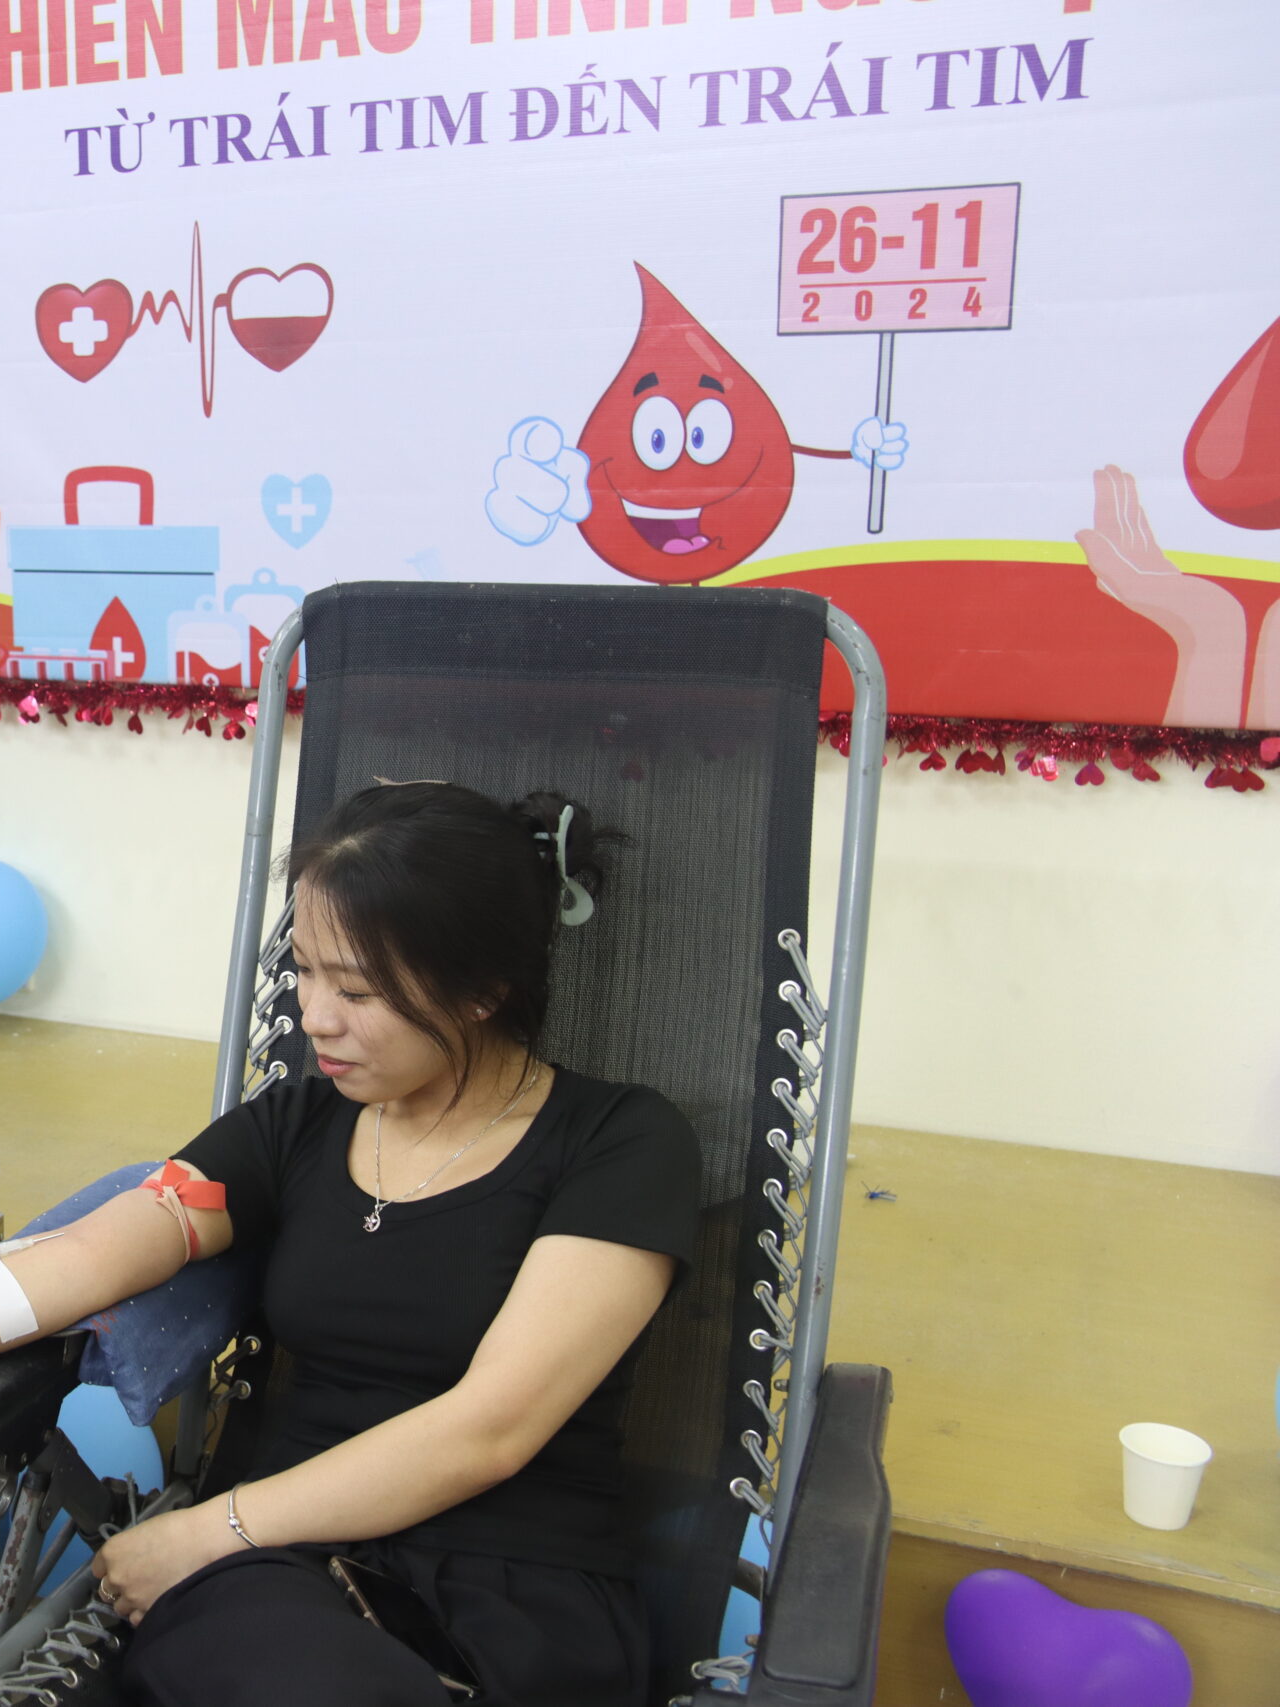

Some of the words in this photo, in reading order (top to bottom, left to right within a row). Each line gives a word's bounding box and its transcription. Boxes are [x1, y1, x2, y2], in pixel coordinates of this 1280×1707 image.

[64, 108, 156, 177] TỪ
[169, 92, 332, 168] TRÁI
[350, 91, 489, 154] TIM
[508, 63, 667, 142] ĐẾN
[689, 41, 892, 128] TRÁI
[916, 37, 1095, 112] TIM
[797, 200, 983, 275] 26-11
